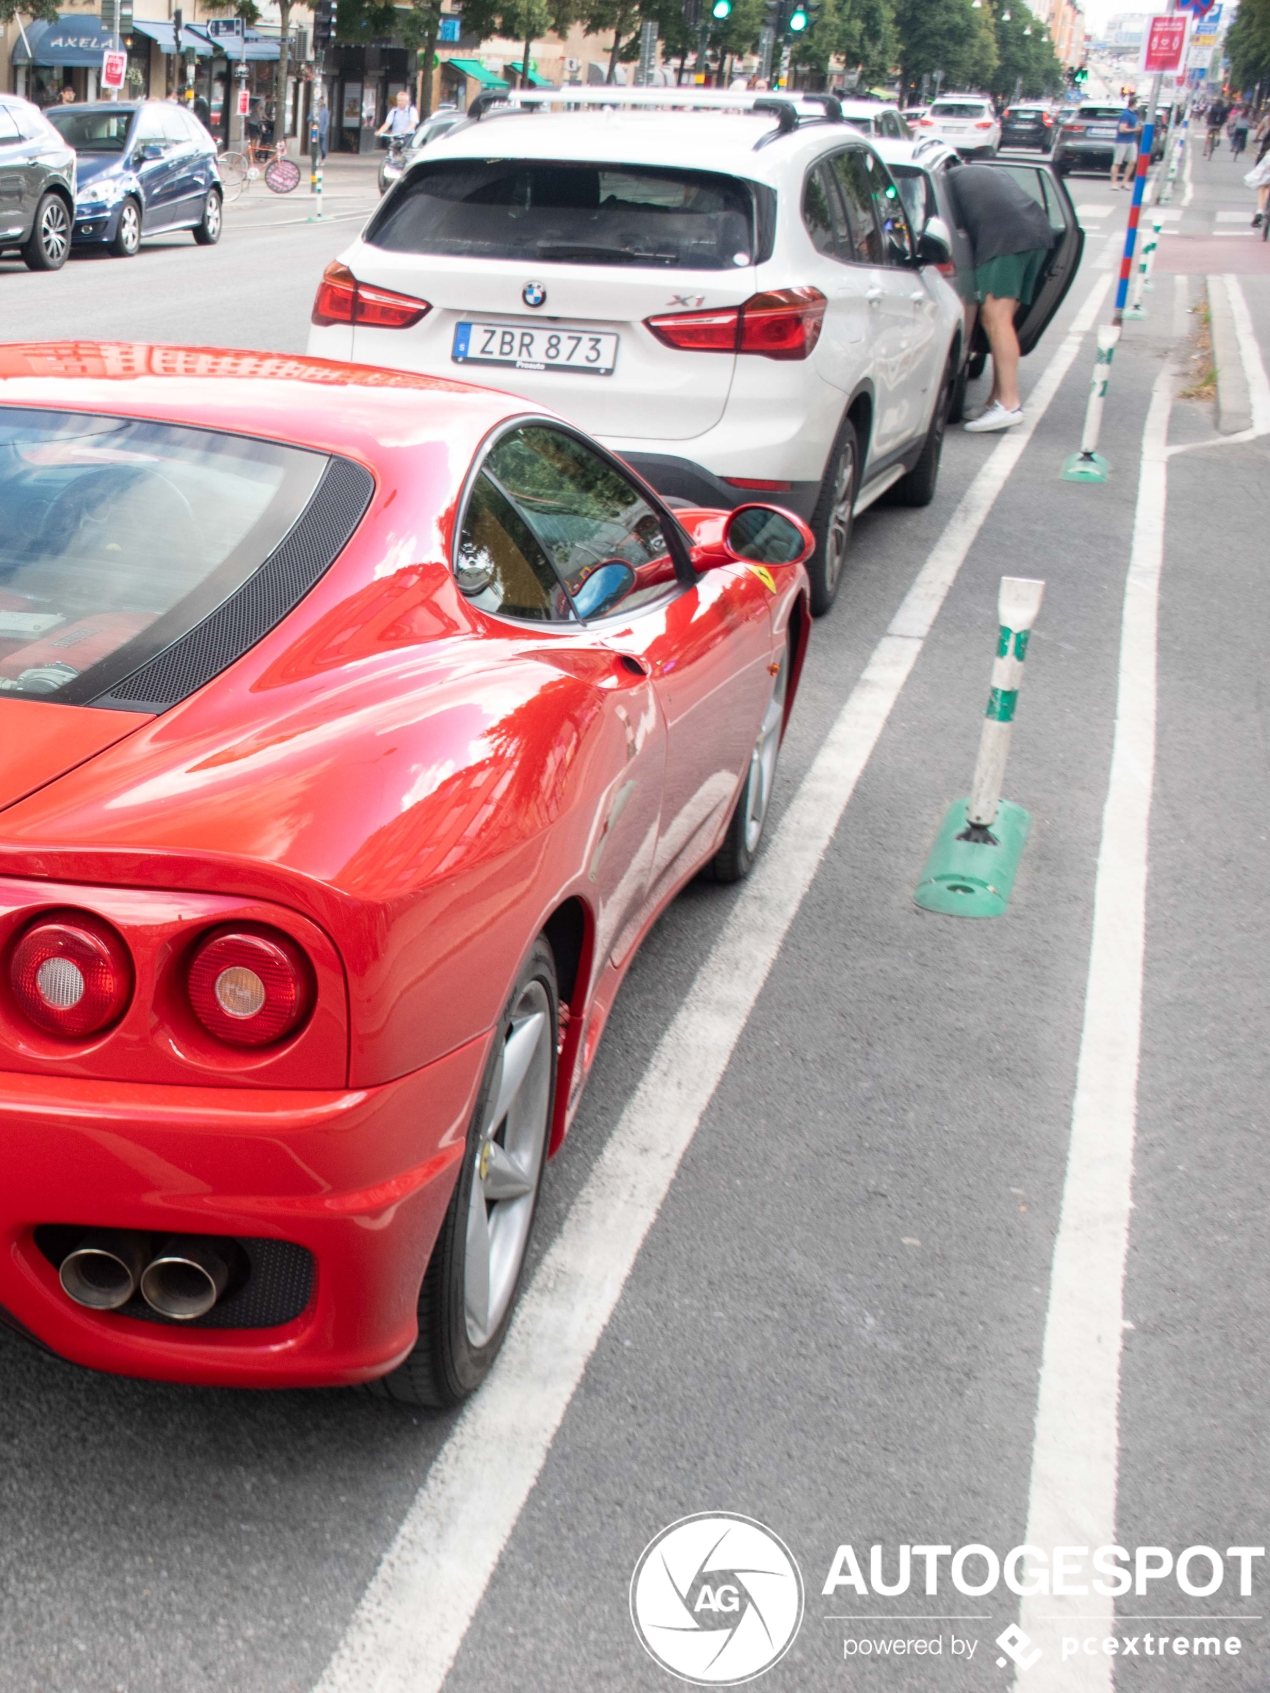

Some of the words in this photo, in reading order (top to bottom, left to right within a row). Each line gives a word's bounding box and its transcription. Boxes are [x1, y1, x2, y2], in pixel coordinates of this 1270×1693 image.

[50, 36, 113, 48] AXELA
[665, 294, 706, 308] X1
[480, 329, 535, 358] ZBR
[545, 334, 602, 364] 873
